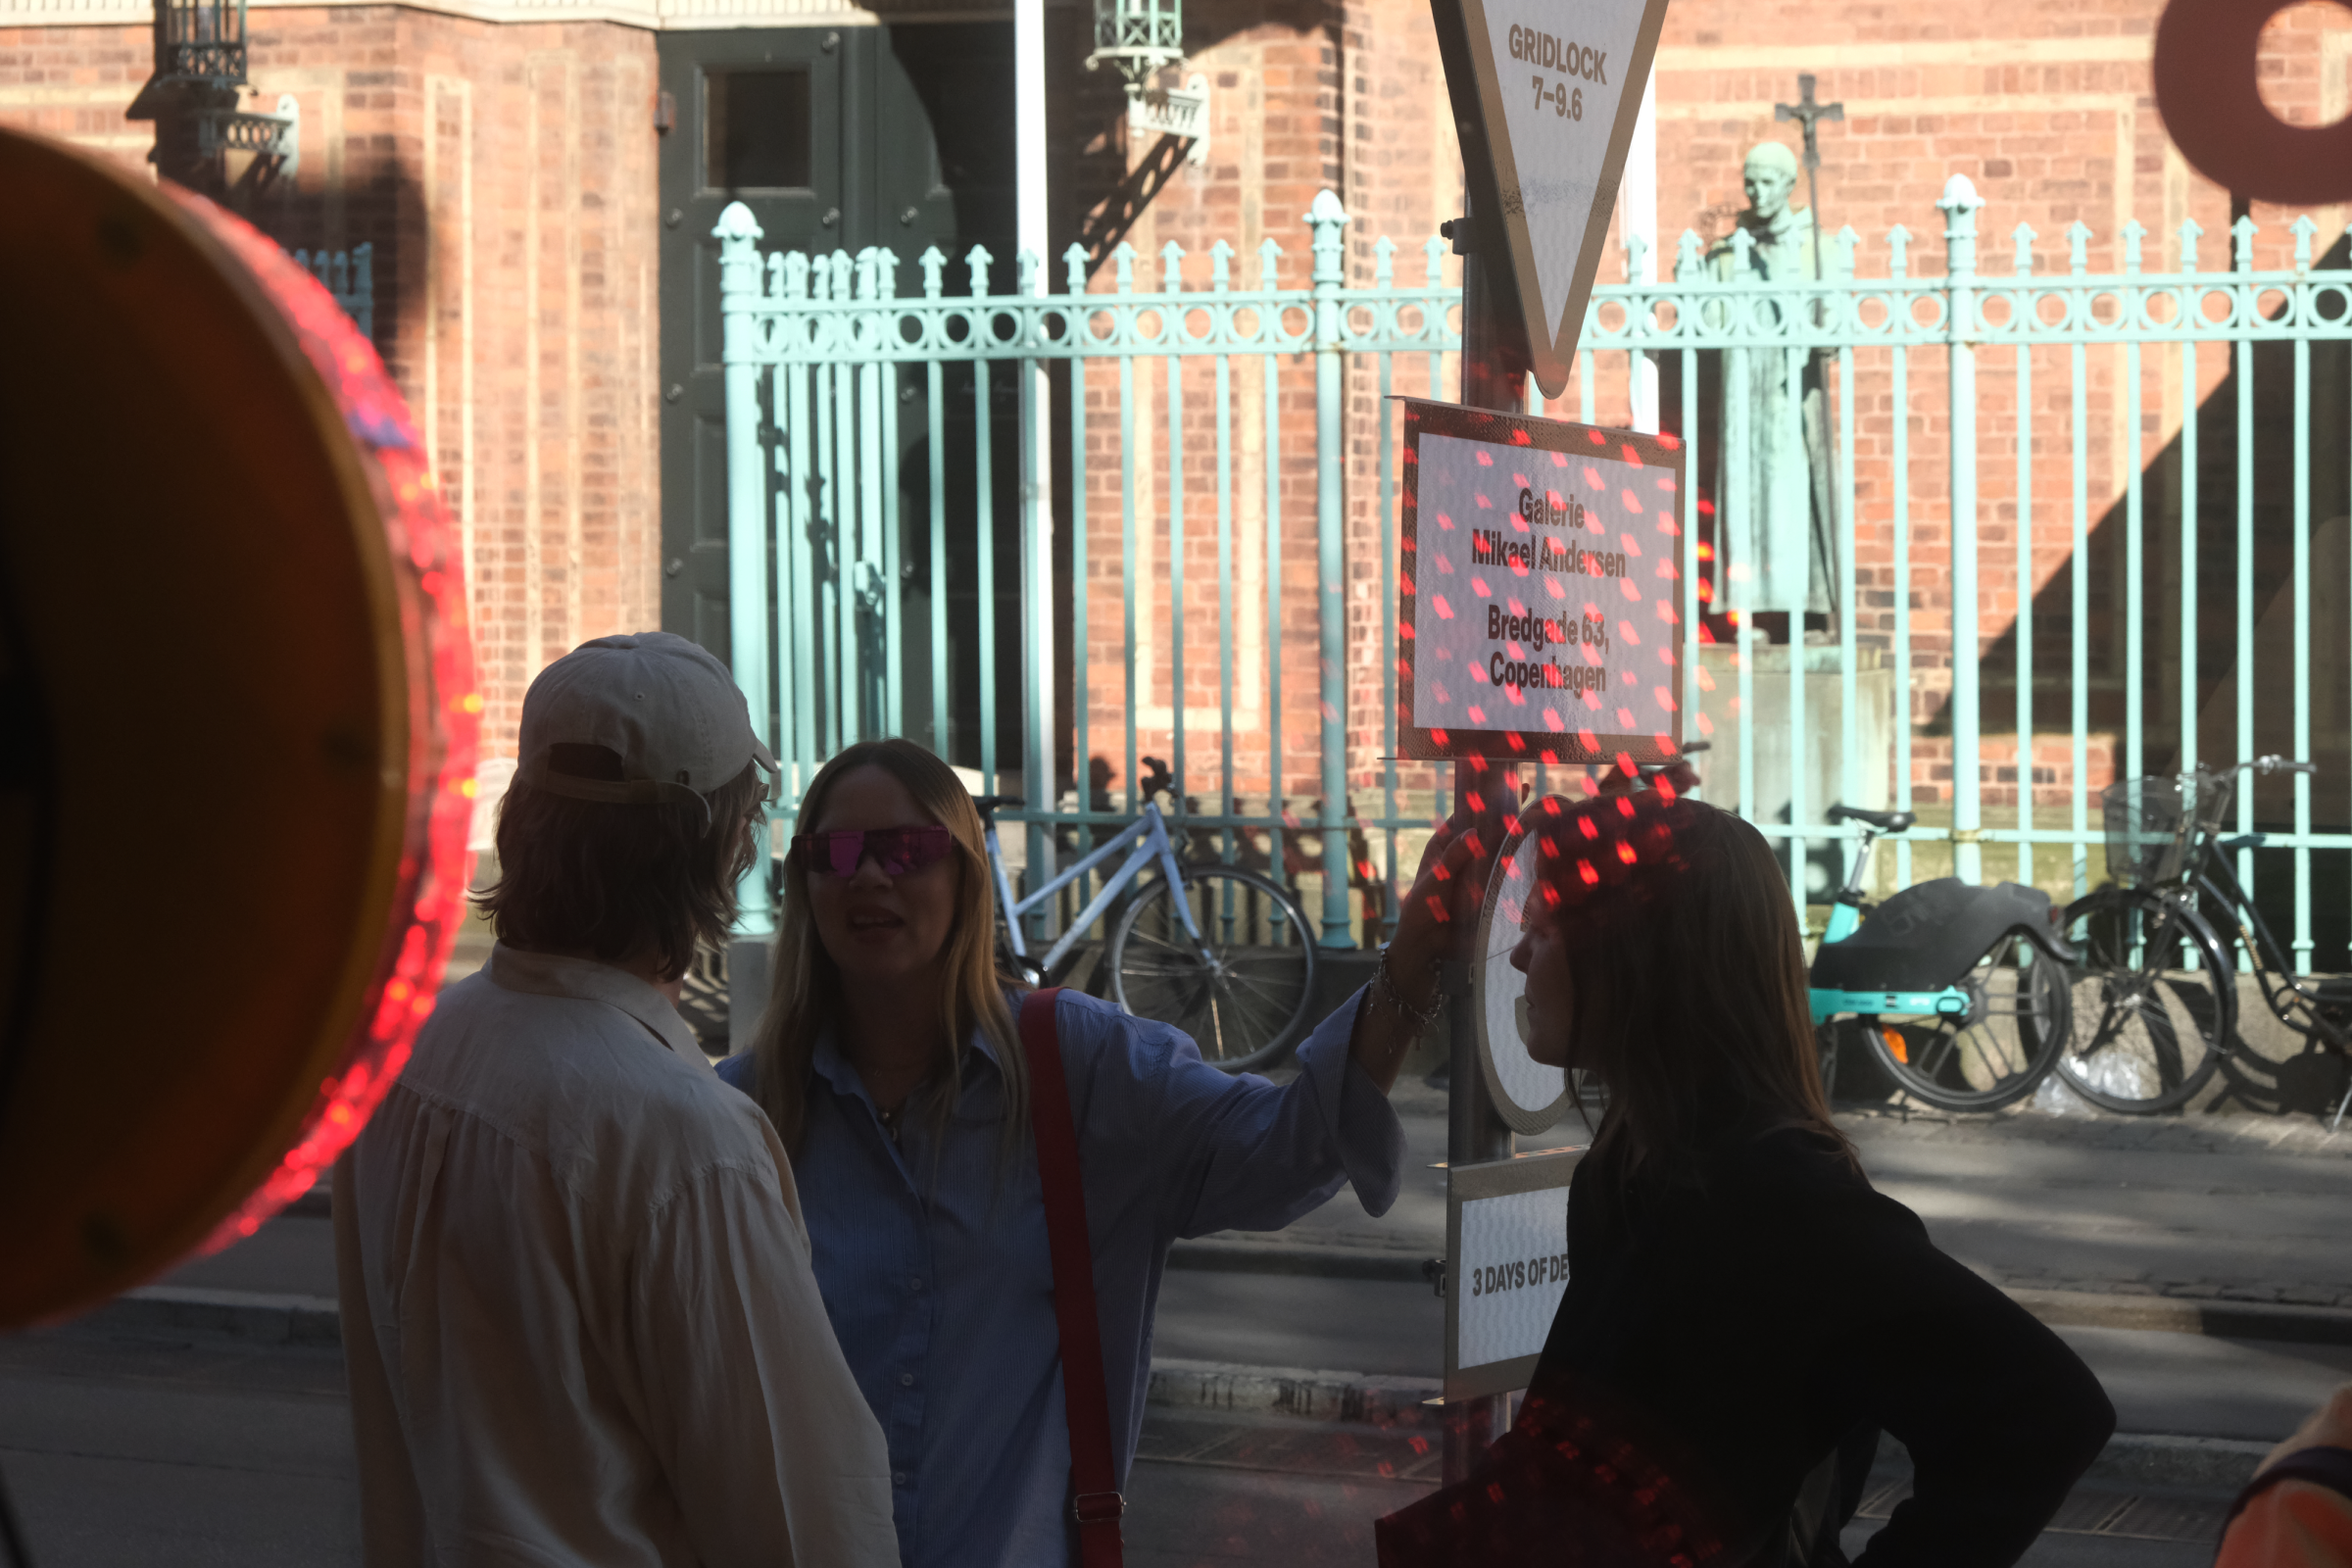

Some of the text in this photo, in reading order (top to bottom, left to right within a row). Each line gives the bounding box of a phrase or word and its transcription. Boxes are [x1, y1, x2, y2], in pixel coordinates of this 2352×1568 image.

[1509, 24, 1607, 85] GRIDLOCK
[1519, 488, 1585, 529] Galerie
[1472, 528, 1626, 577] Mikael Andersen
[1488, 604, 1609, 655] Bredgade 63,
[1490, 651, 1606, 700] Copenhagen
[1473, 1268, 1483, 1297] 3
[1486, 1260, 1526, 1295] DAYS
[1528, 1256, 1547, 1287] OF
